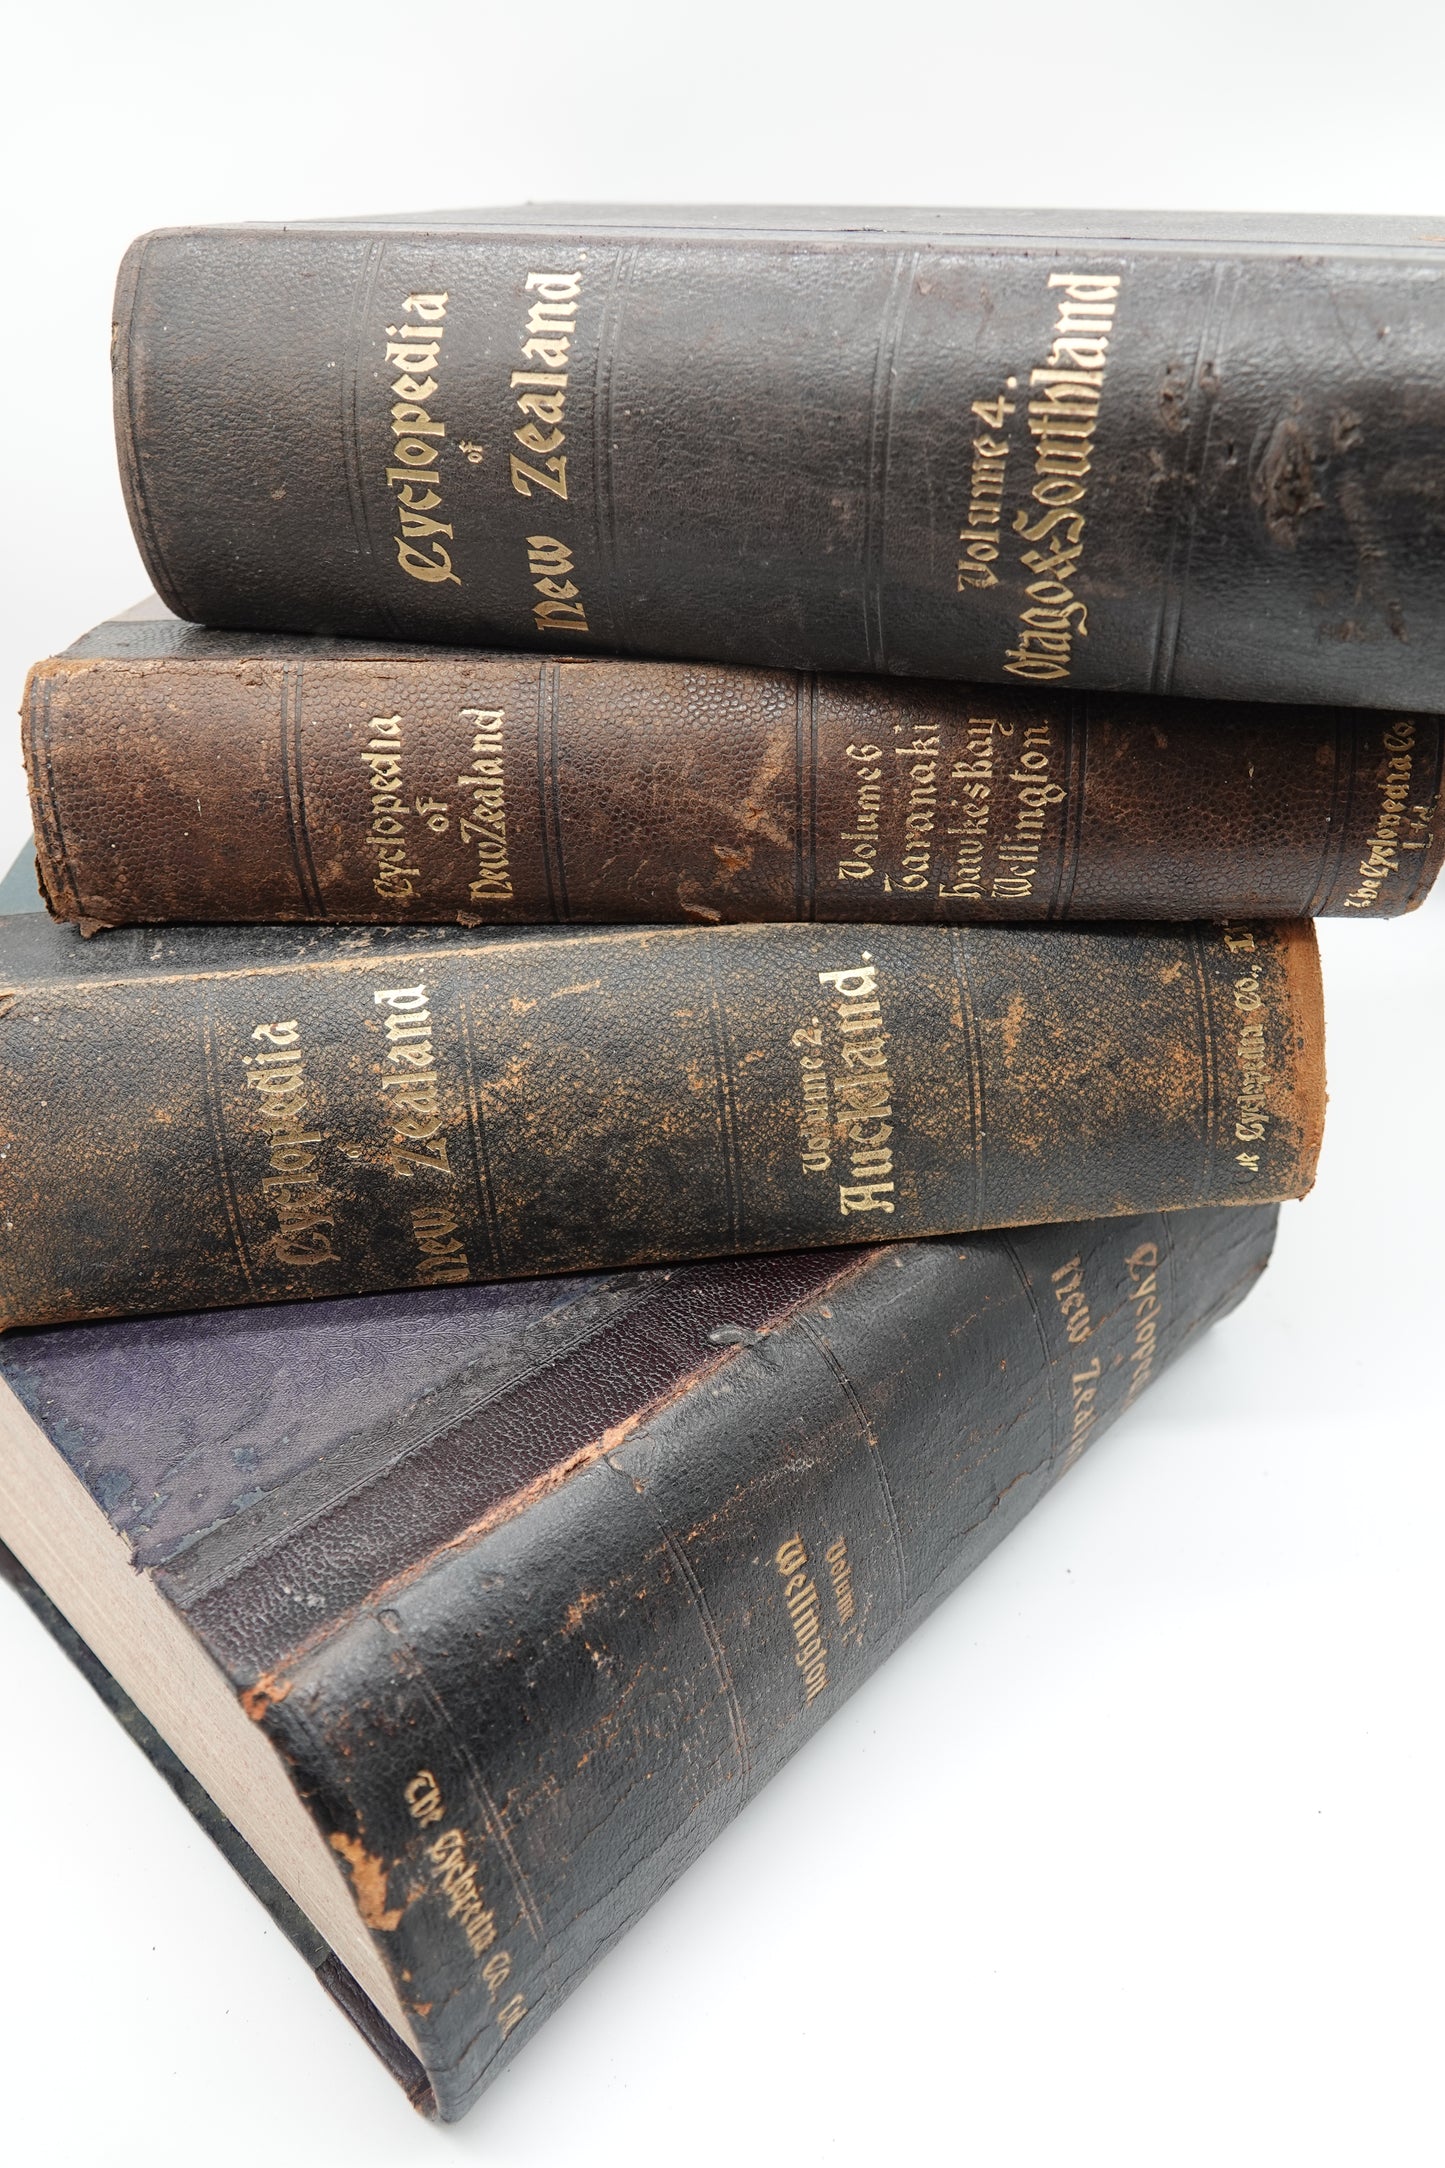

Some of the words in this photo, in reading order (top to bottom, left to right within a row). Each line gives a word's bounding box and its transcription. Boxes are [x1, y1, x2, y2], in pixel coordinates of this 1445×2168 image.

[385, 291, 461, 585] Cyclopedia
[458, 440, 483, 464] of
[971, 377, 1017, 428] 4.
[525, 535, 589, 631] New
[957, 434, 1009, 591] Volume
[361, 715, 420, 897] Cyclopedia
[415, 796, 449, 832] of
[838, 767, 881, 880] Volume
[883, 724, 940, 892] Taranaki
[992, 719, 1067, 898] Wellington.
[242, 1020, 341, 1265] Cyclopedia
[818, 951, 895, 1215] Auckland.
[410, 1207, 470, 1282] New
